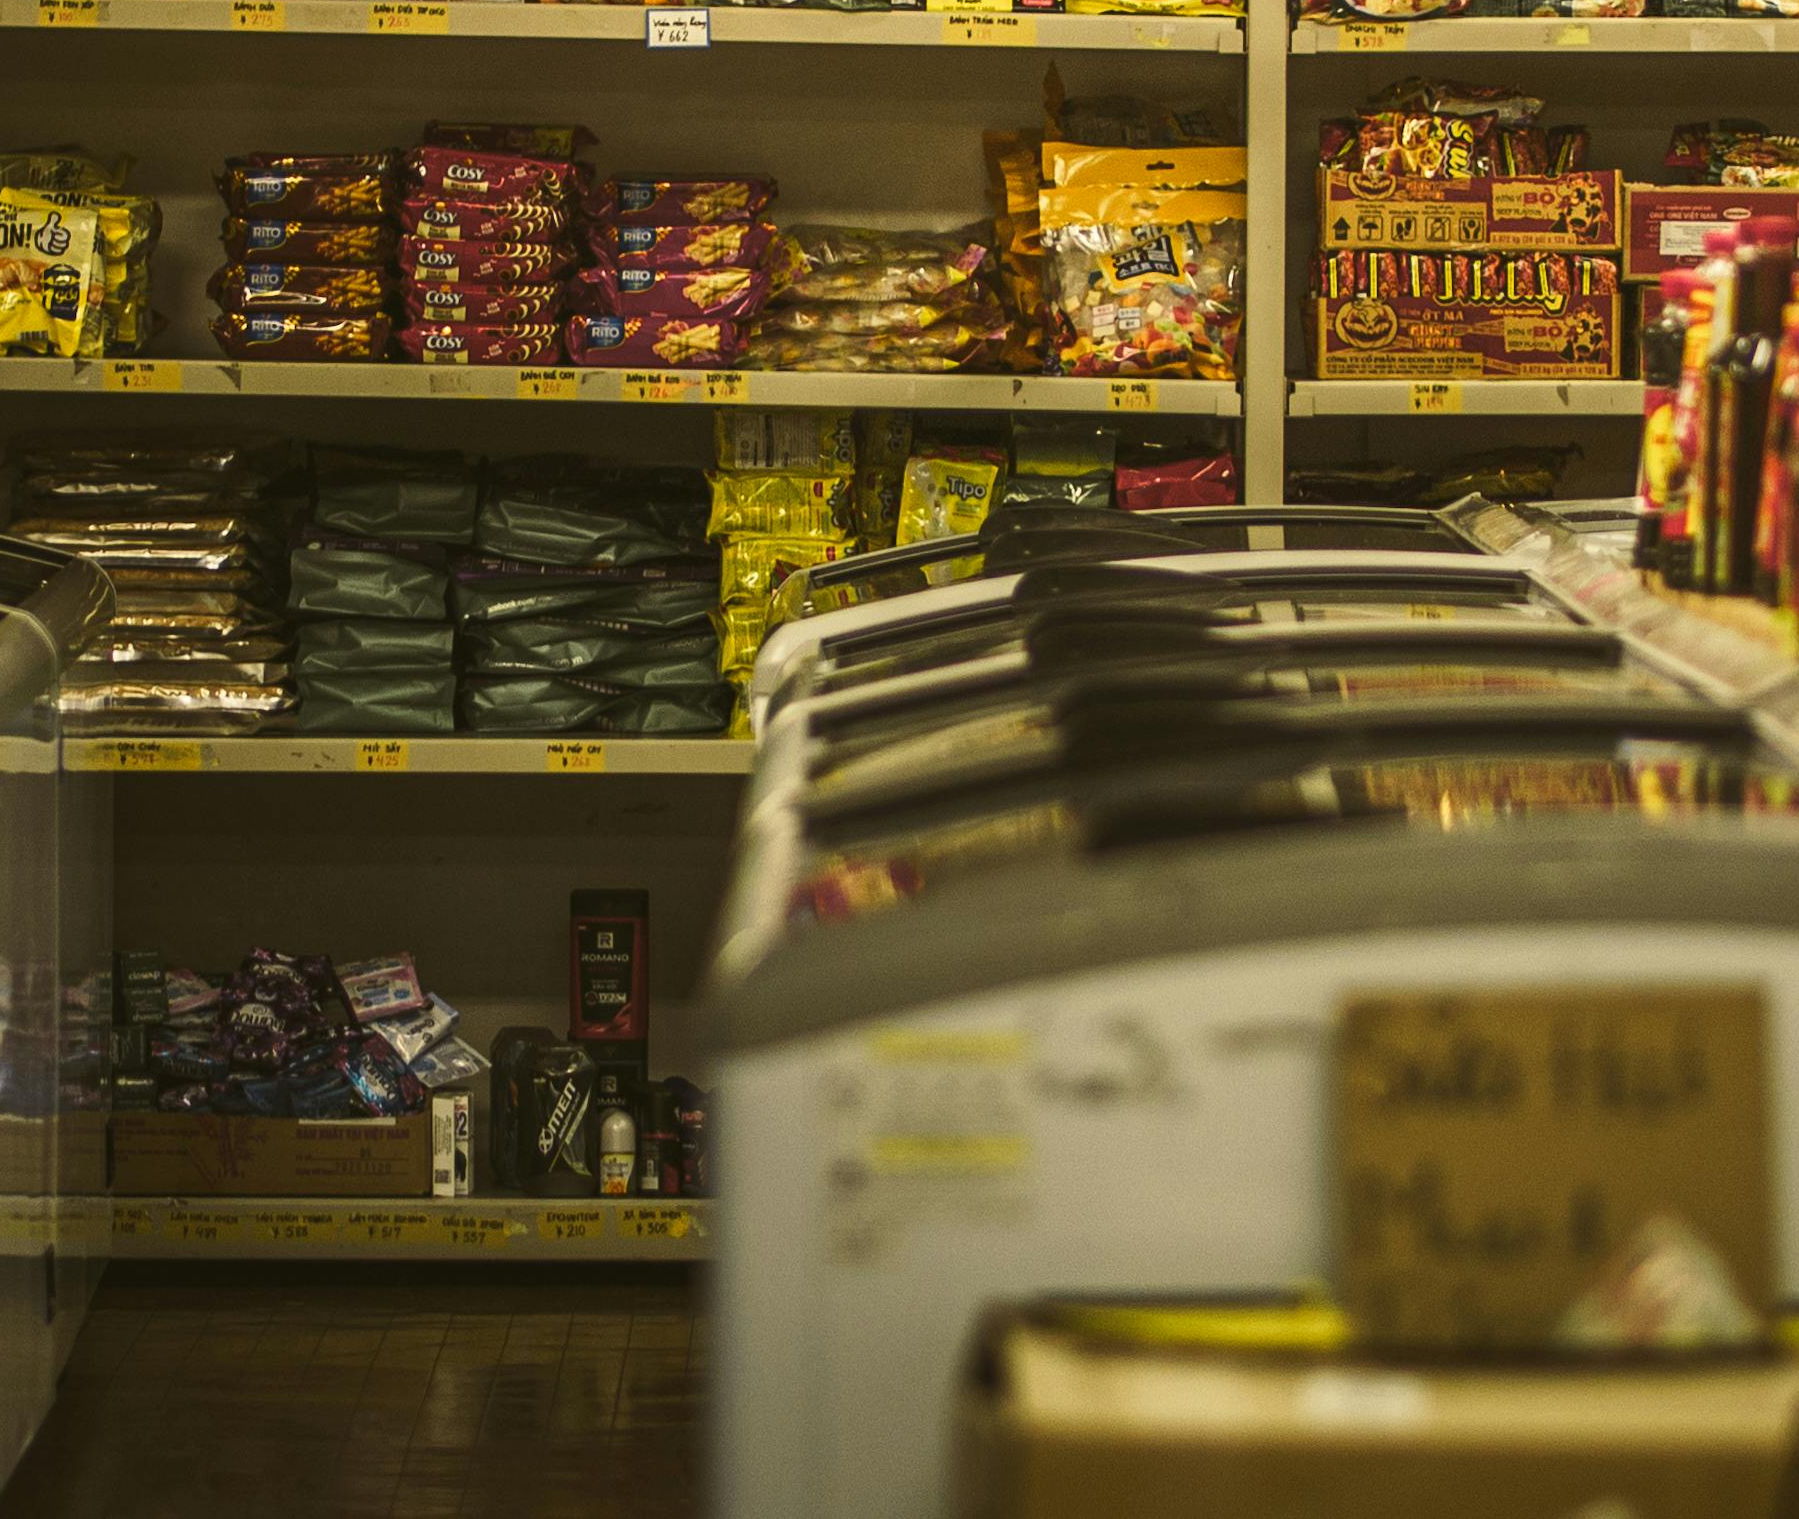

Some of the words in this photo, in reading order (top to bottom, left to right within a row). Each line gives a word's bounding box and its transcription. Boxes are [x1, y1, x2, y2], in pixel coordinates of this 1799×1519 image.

[657, 31, 664, 42] ¥
[668, 31, 689, 43] 662
[444, 163, 487, 182] COSY
[1522, 188, 1556, 207] BÒ
[422, 206, 459, 226] COSY
[418, 250, 458, 269] COSY
[424, 290, 465, 309] COSY
[1532, 321, 1563, 340] BÒ
[425, 334, 466, 352] COSY
[945, 475, 987, 500] Tipo
[580, 952, 631, 964] ROMANO
[566, 1224, 586, 1238] 210
